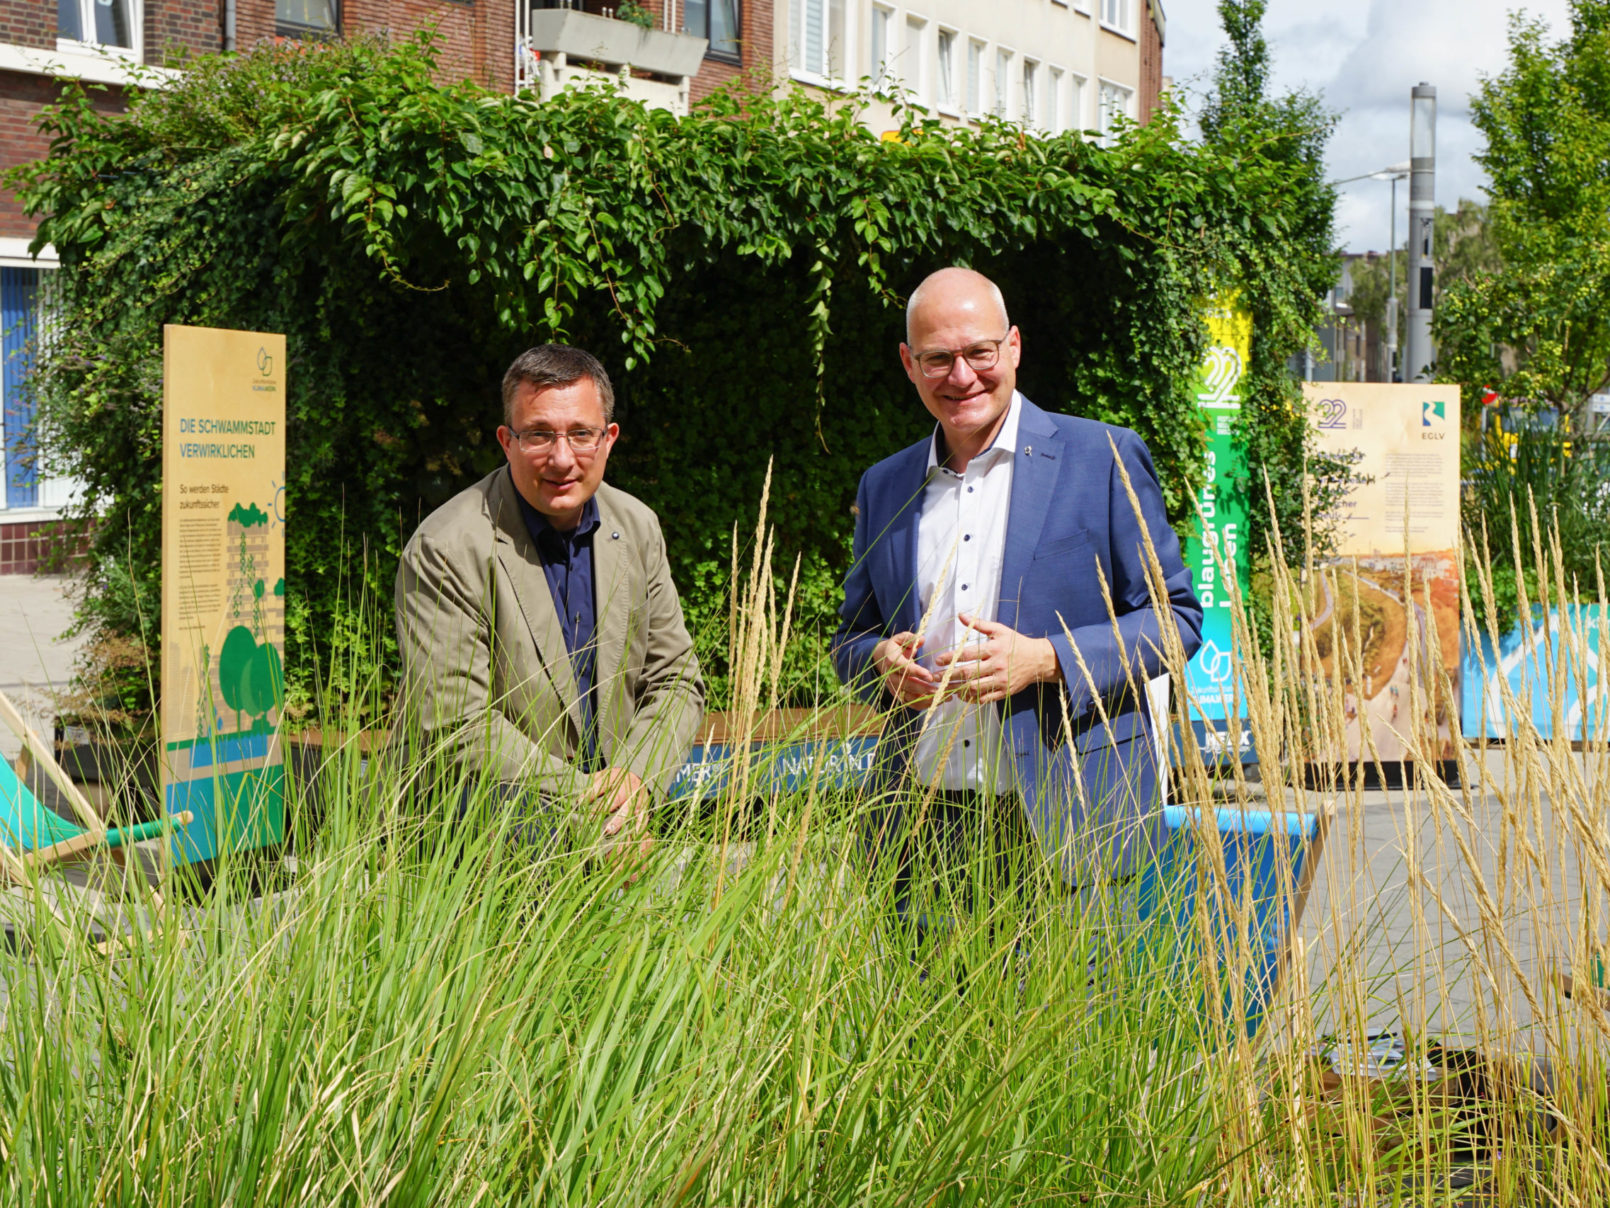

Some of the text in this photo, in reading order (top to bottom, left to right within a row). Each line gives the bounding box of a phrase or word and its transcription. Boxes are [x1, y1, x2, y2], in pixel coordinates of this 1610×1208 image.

[180, 418, 276, 435] DIE SCHWAMMSTADT
[1421, 432, 1446, 440] EGLV
[180, 443, 255, 458] VERWIRKLICHEN
[179, 484, 188, 494] So
[190, 484, 210, 494] werden
